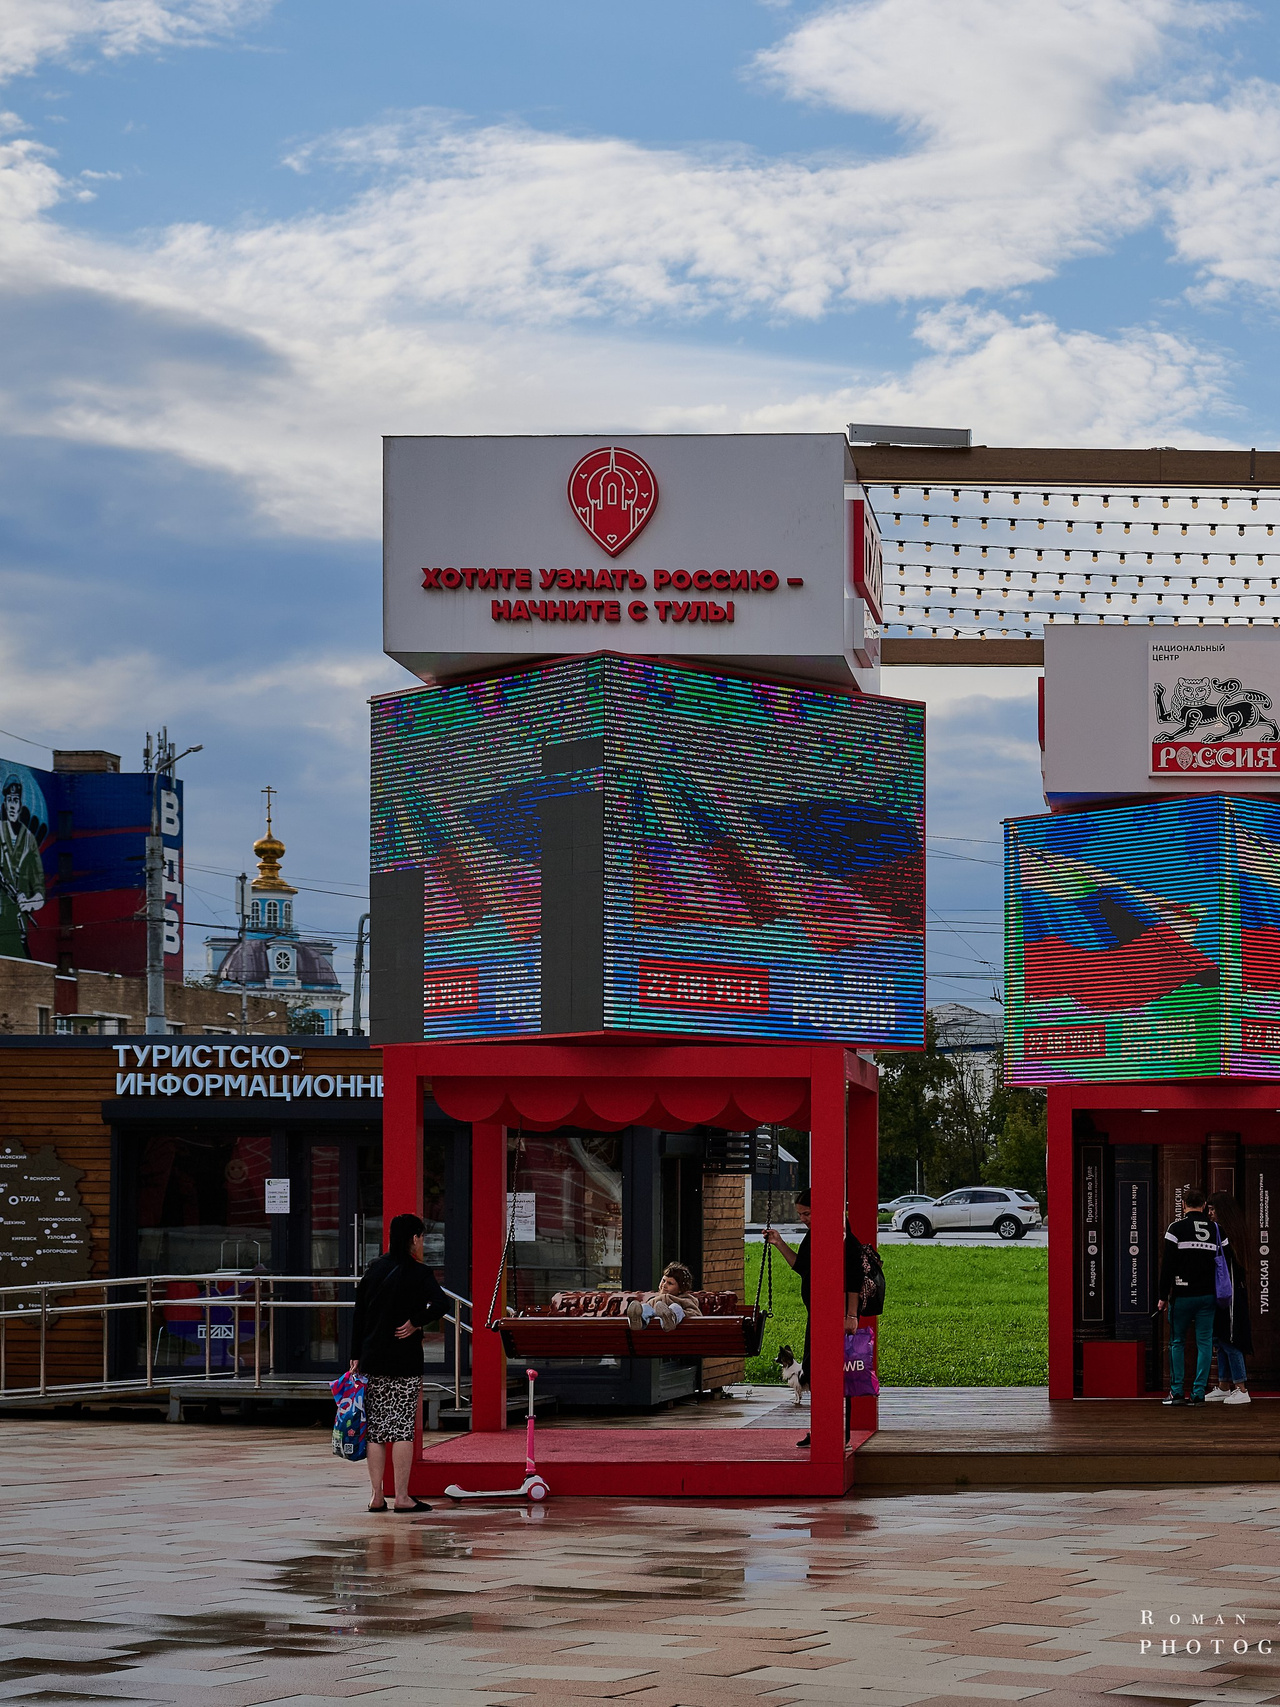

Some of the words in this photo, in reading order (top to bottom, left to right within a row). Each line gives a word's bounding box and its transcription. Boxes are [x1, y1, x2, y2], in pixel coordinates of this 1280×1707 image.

[421, 567, 532, 590] ХОТИТЕ
[538, 568, 647, 591] УЗНАТЬ
[653, 569, 779, 592] РОССИЮ
[491, 599, 621, 622] НАЧНИТЕ
[628, 600, 649, 623] С
[654, 600, 736, 623] ТУЛЫ
[1152, 643, 1226, 654] НАЦИОНАЛЬНЫЙ
[1152, 654, 1180, 663] ЦЕНТР
[1157, 745, 1278, 770] РОССИЯ
[424, 976, 473, 1005] ВГУСТА
[112, 1044, 302, 1068] ТУРИСТСКО-
[1086, 1165, 1094, 1181] Туле
[1087, 1181, 1094, 1191] по
[1131, 1184, 1139, 1200] мир
[19, 1195, 41, 1203] ТУЛА
[1086, 1192, 1094, 1223] Прогулка
[1129, 1207, 1138, 1230] Война
[1193, 1220, 1211, 1242] 5
[1089, 1260, 1097, 1288] Андреев
[1260, 1259, 1269, 1315] ТУЛЬСКАЯ
[844, 1359, 865, 1372] WB
